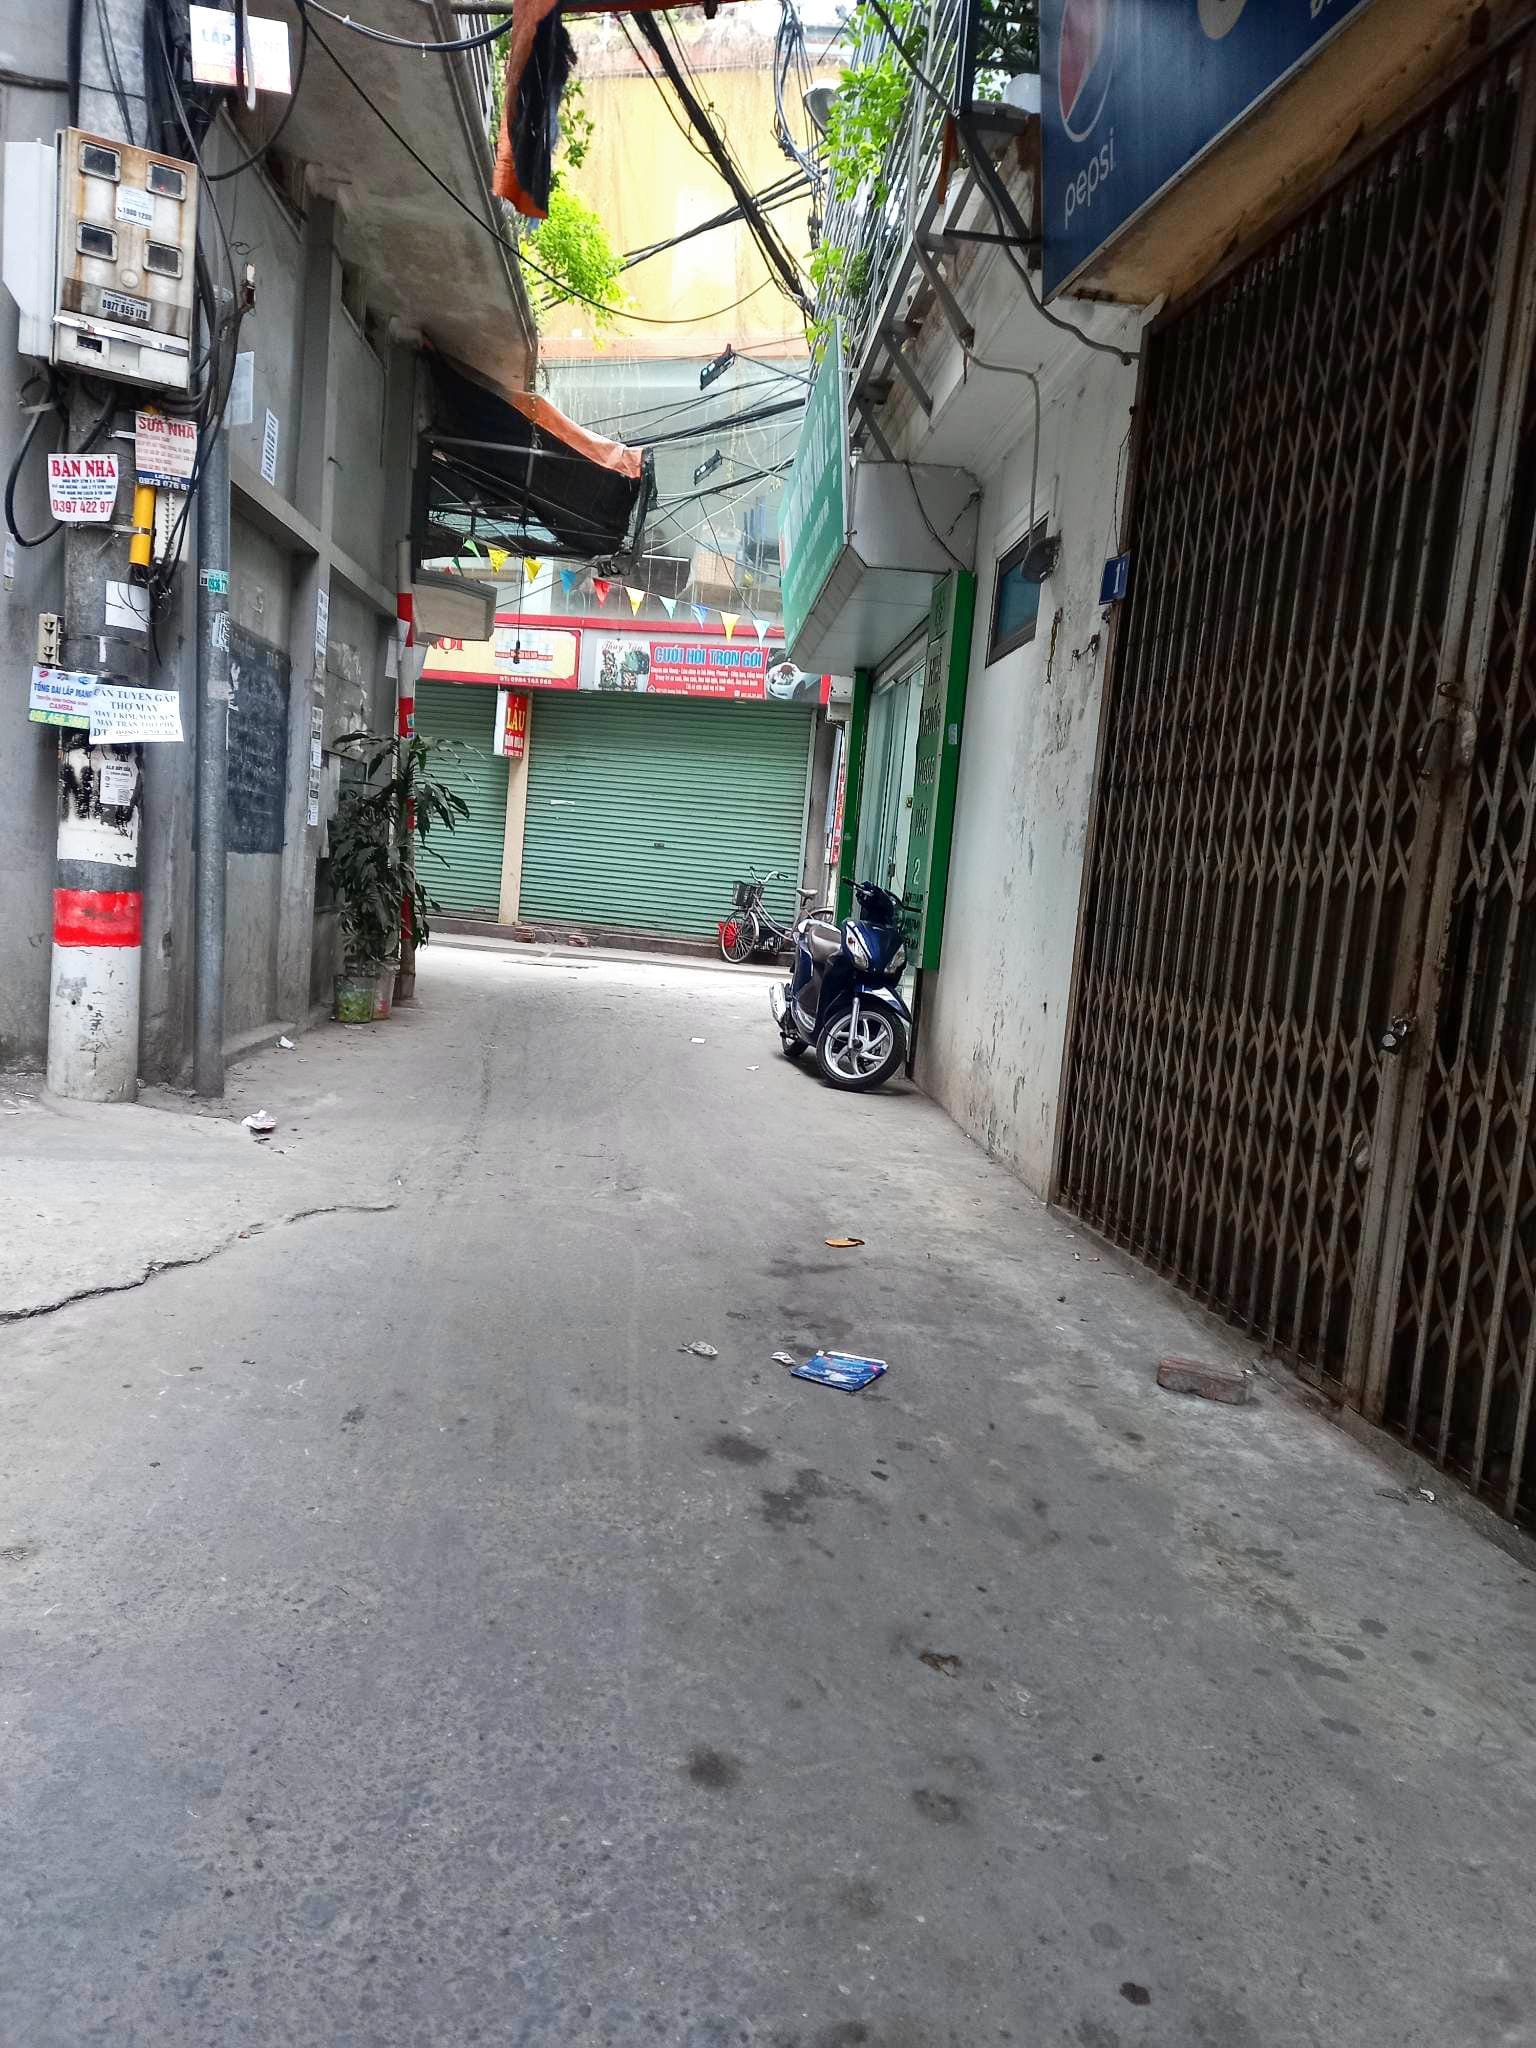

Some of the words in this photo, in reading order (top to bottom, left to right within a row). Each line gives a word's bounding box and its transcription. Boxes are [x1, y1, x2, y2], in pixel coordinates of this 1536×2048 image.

[1064, 127, 1116, 230] pepsi
[53, 499, 77, 514] 0397
[80, 500, 97, 514] 422
[655, 644, 685, 664] CƯỚI
[686, 643, 707, 666] HỎI
[709, 648, 741, 669] TRỌN
[741, 648, 763, 668] GÓI
